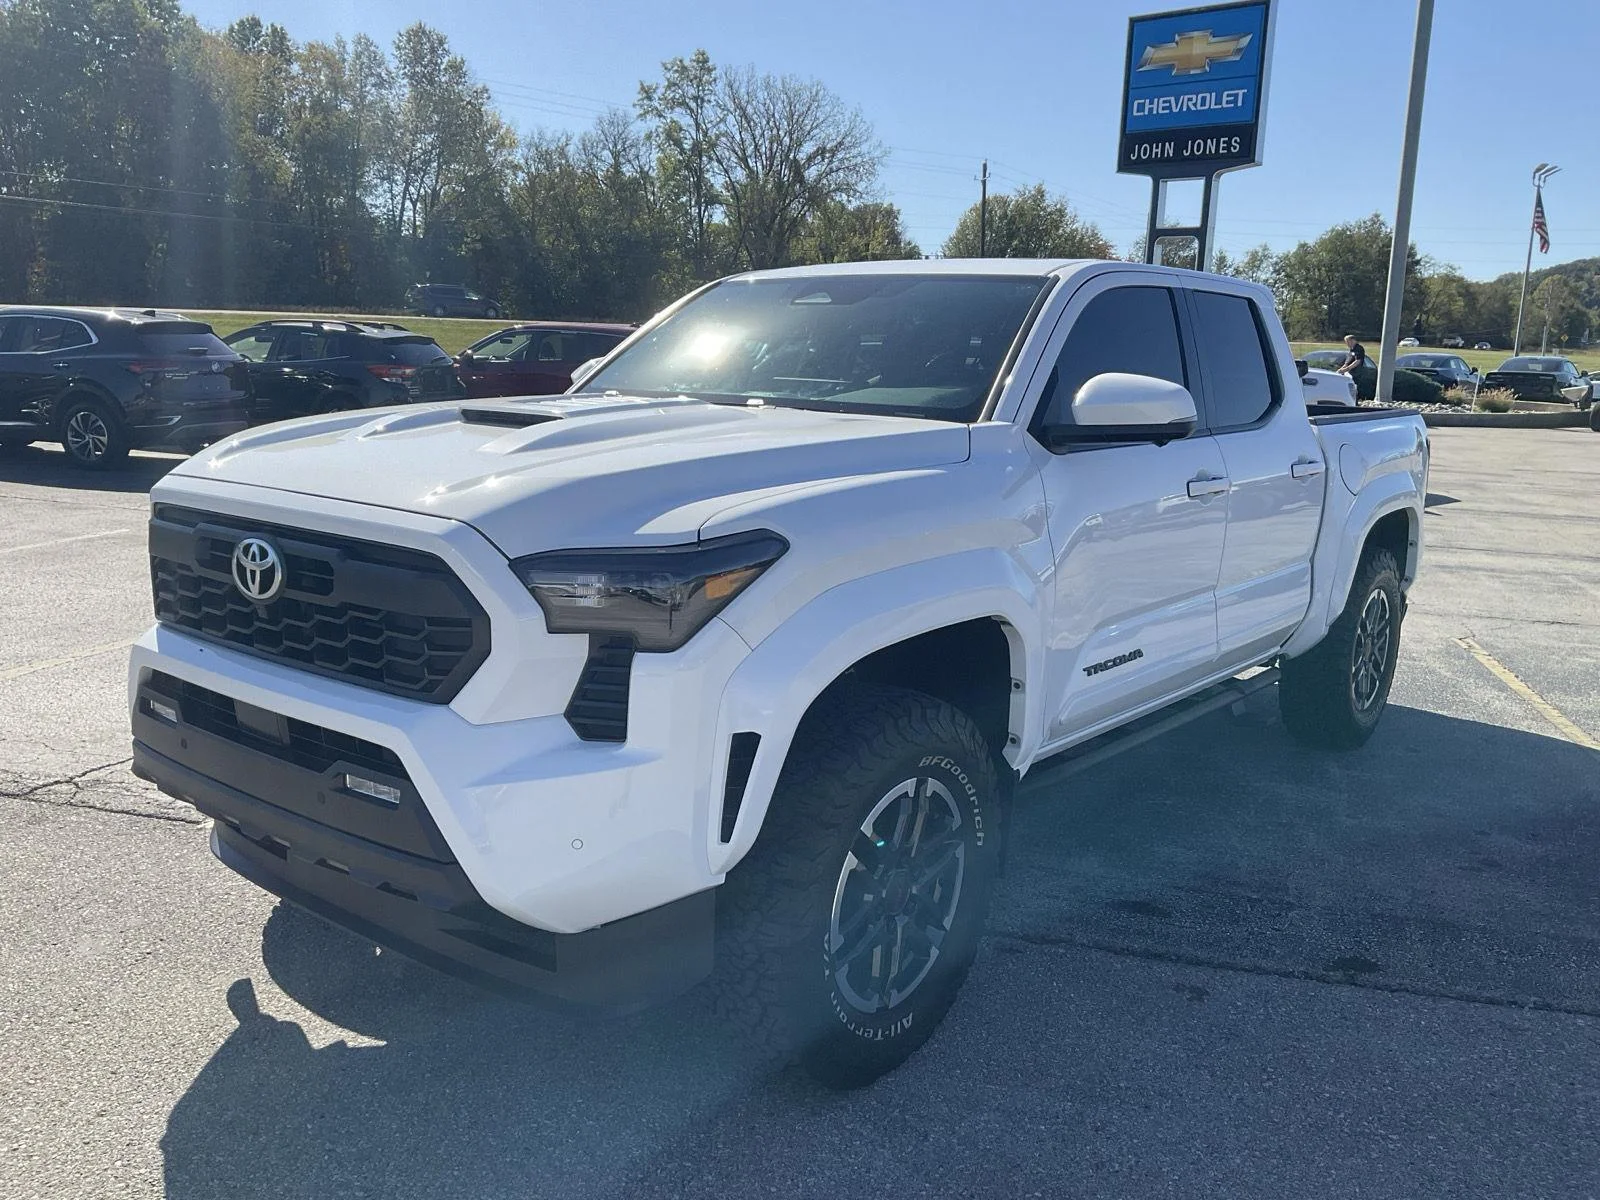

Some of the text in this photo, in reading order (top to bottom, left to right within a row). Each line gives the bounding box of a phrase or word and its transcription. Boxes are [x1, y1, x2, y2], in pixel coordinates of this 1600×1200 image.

[1133, 89, 1248, 117] CHEVROLET
[1130, 136, 1240, 160] JOHN JONES
[1082, 648, 1144, 677] TACOMA
[918, 756, 985, 846] BFGoodrich
